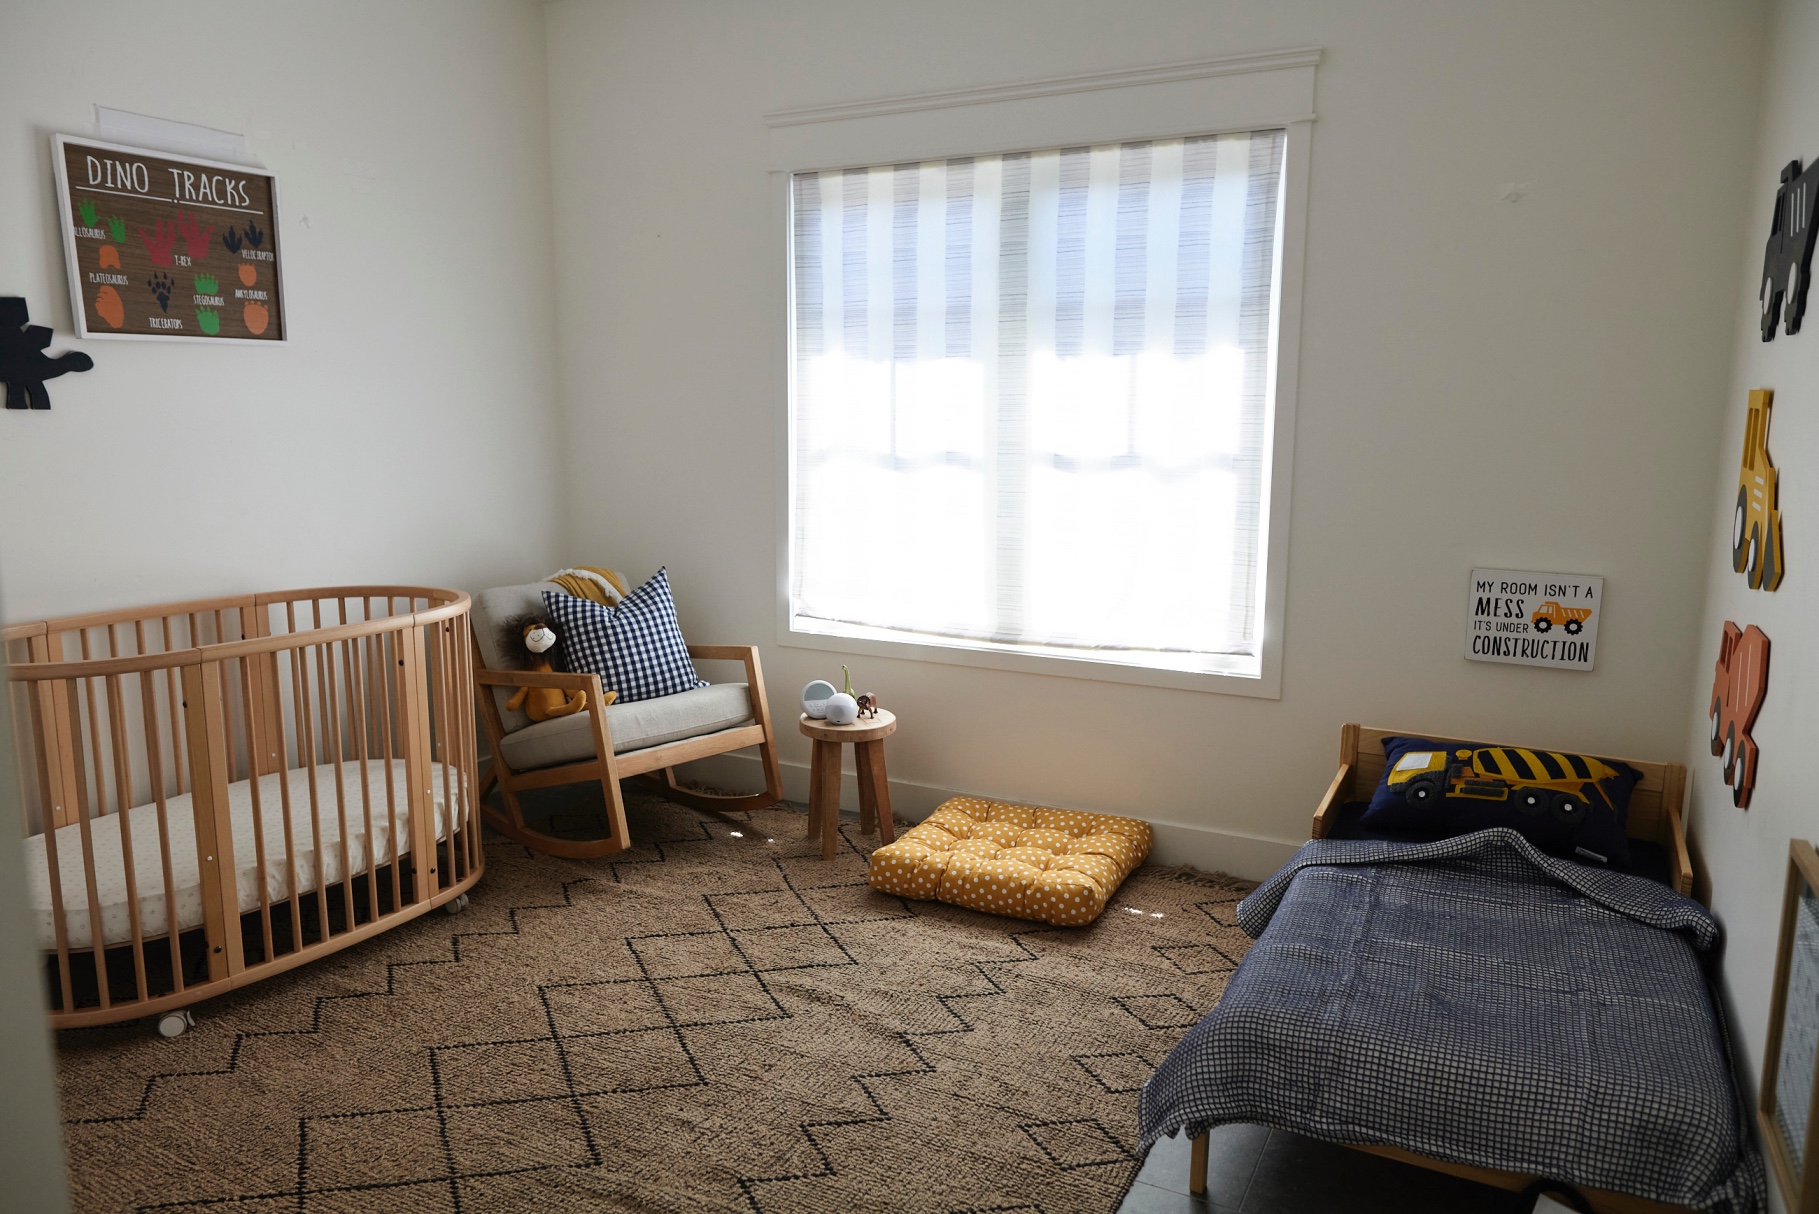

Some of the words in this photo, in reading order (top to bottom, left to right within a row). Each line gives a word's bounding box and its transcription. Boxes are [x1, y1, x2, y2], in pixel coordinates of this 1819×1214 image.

[86, 155, 149, 193] DINO
[168, 168, 250, 207] TRACKS
[174, 255, 192, 267] T-REX
[89, 272, 129, 285] PLATEOSAURUS
[193, 294, 225, 307] STEGOSAURUS
[235, 288, 268, 300] ANKYLOSAURUS
[1476, 580, 1495, 594] MY
[1500, 581, 1538, 596] ROOM
[1544, 584, 1580, 598] ISN'T
[1585, 586, 1594, 599] A
[1475, 596, 1525, 619] MESS
[1473, 620, 1492, 632] IT'S
[1495, 622, 1529, 634] UNDER
[1472, 635, 1590, 663] CONSTRUCTION
